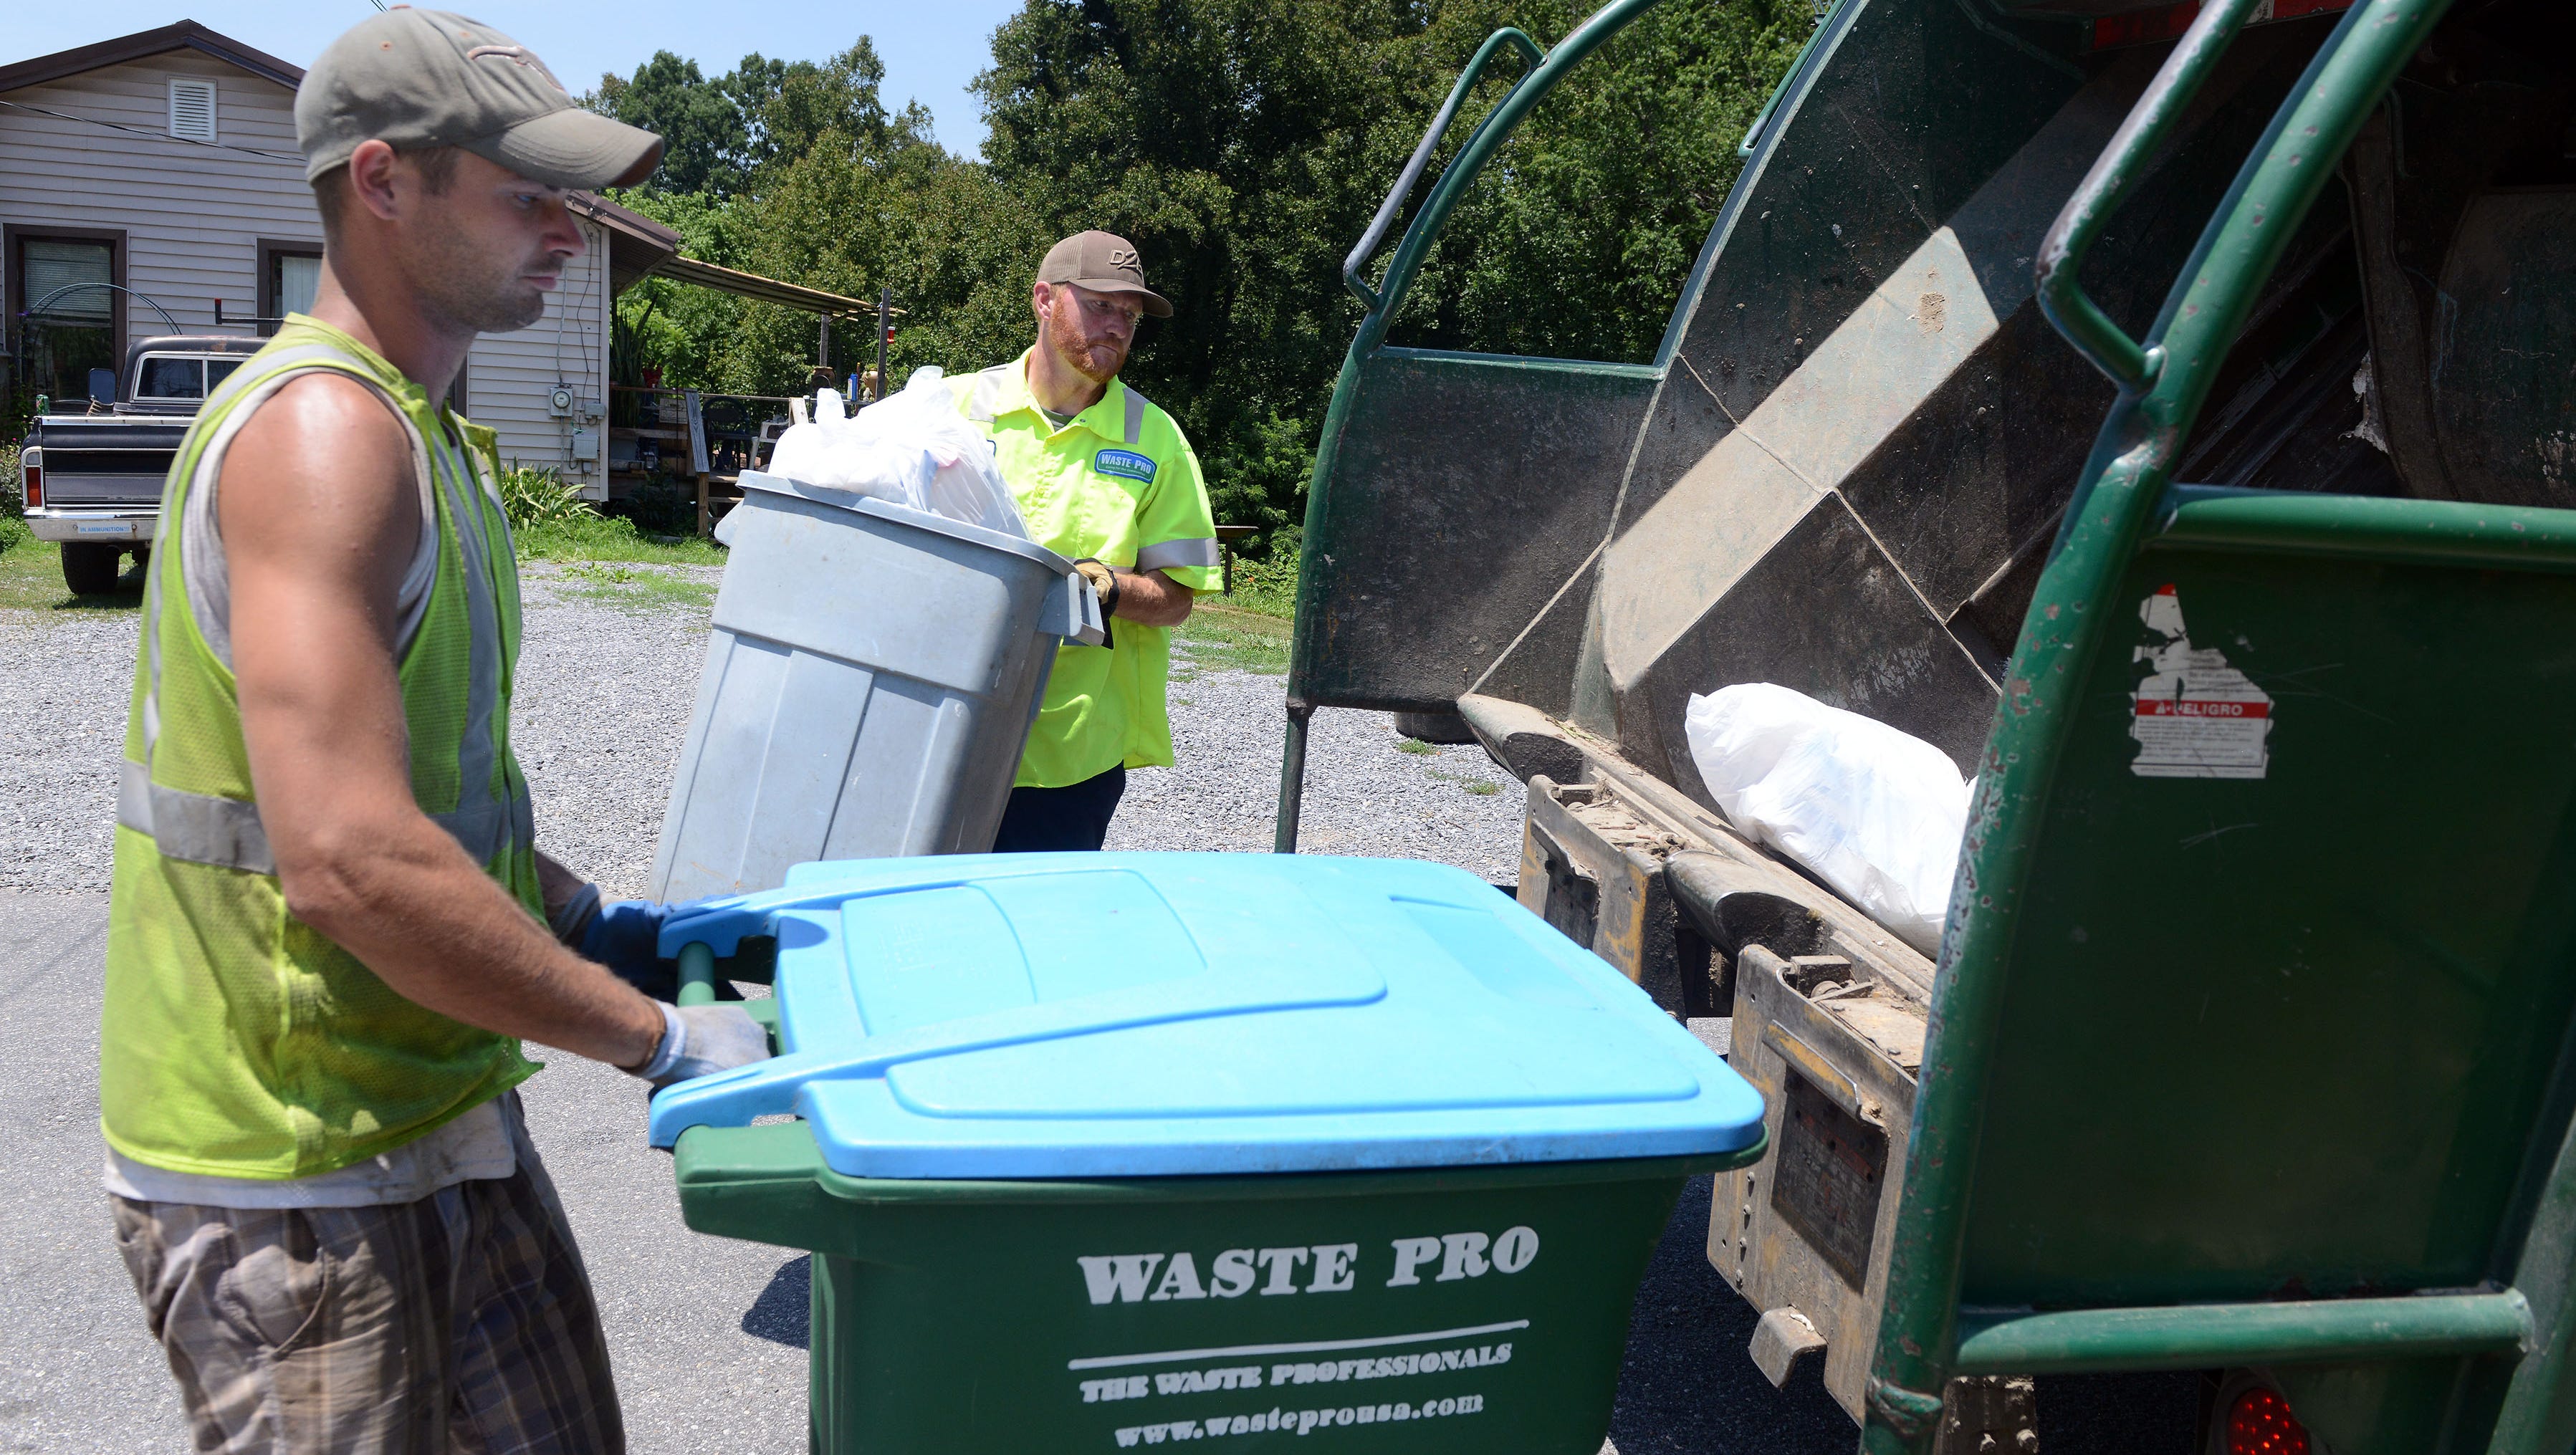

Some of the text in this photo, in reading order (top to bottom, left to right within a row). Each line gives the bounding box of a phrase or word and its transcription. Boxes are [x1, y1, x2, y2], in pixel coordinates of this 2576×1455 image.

[1101, 454, 1151, 474] WASTE PRO
[1077, 1226, 1539, 1305] WASTE PRO
[1080, 1343, 1513, 1403] THE WASTE PROFESSIONALS
[1114, 1394, 1484, 1448] www.wasteprousa.com
